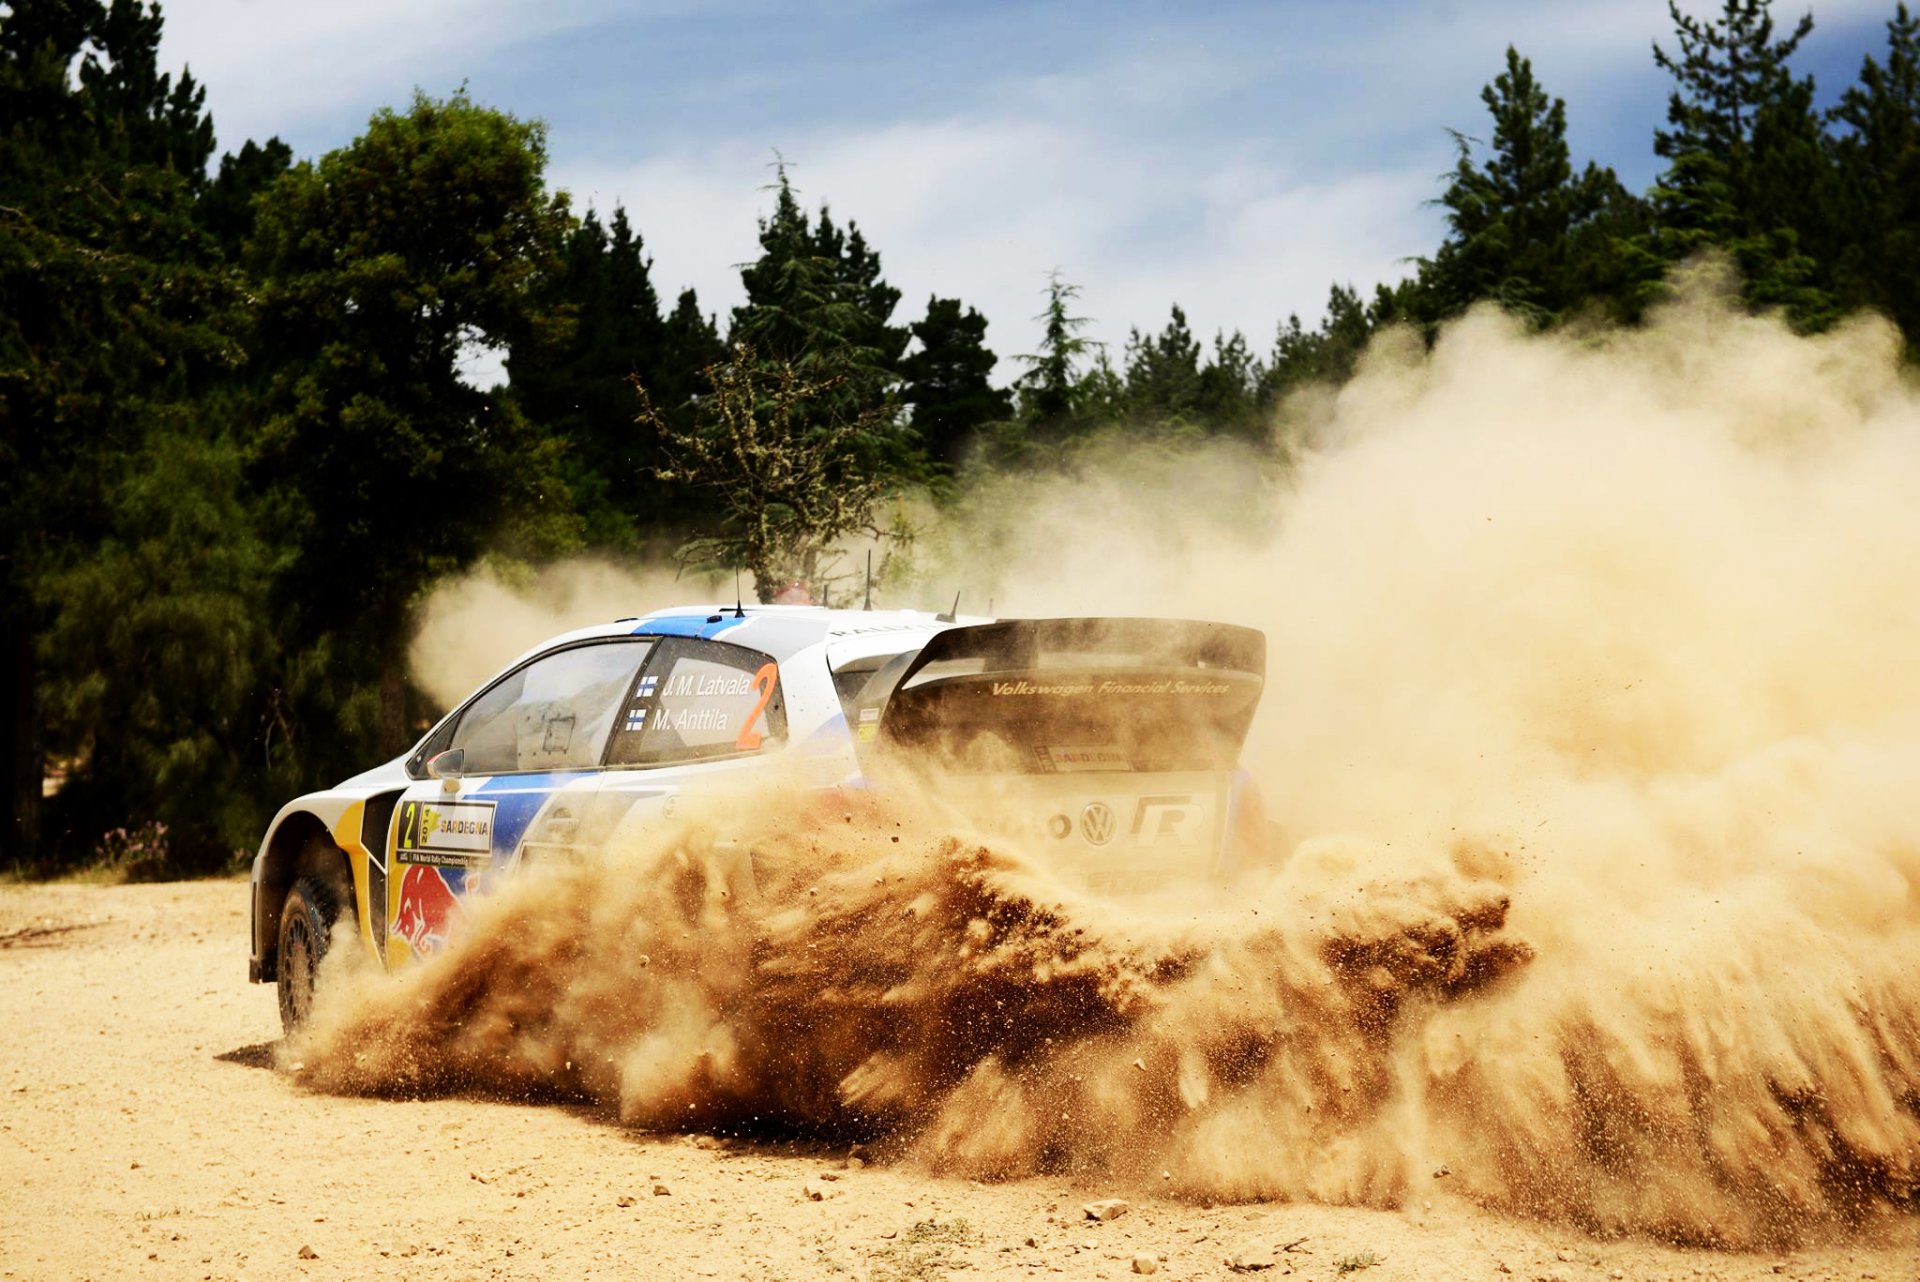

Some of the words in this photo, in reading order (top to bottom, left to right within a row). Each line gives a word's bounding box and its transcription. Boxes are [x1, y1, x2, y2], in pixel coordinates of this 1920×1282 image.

[677, 675, 693, 697] M.
[695, 674, 751, 697] Latvala
[992, 681, 1093, 697] Volkswagen
[1097, 681, 1171, 694] Financial
[1170, 680, 1230, 695] Services
[735, 662, 778, 750] 2
[652, 708, 671, 731] M.
[675, 708, 728, 731] Anttila
[403, 802, 416, 849] 2
[421, 808, 431, 844] 2014
[440, 819, 489, 836] SARDEGNA
